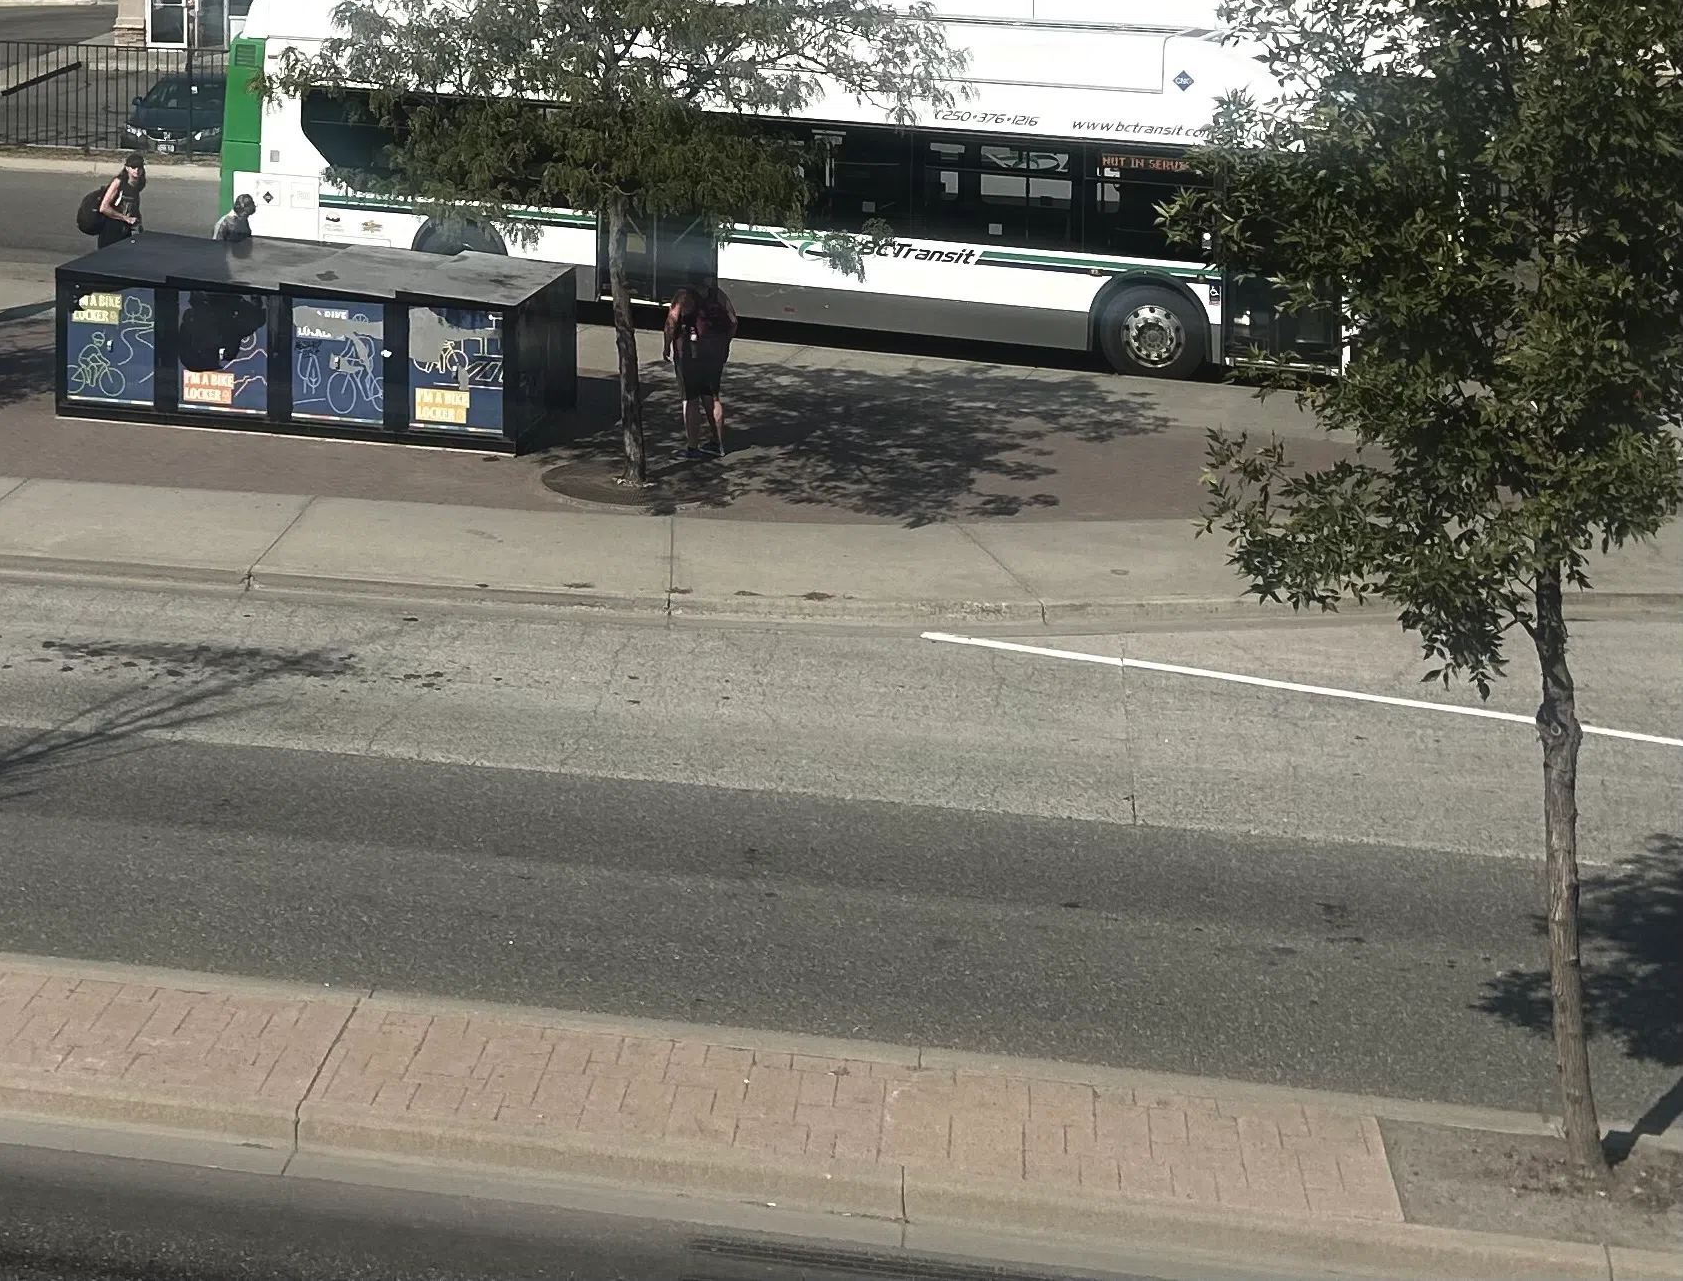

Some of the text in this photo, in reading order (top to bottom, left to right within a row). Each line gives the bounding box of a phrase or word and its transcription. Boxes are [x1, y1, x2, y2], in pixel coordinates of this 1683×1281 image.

[1102, 156, 1126, 166] NOT
[1131, 158, 1145, 168] IN
[99, 295, 122, 308] BIKE
[211, 374, 233, 388] BIKE
[185, 387, 222, 402] LOCKER
[445, 392, 468, 407] BIKE
[417, 405, 455, 421] LOCKER
